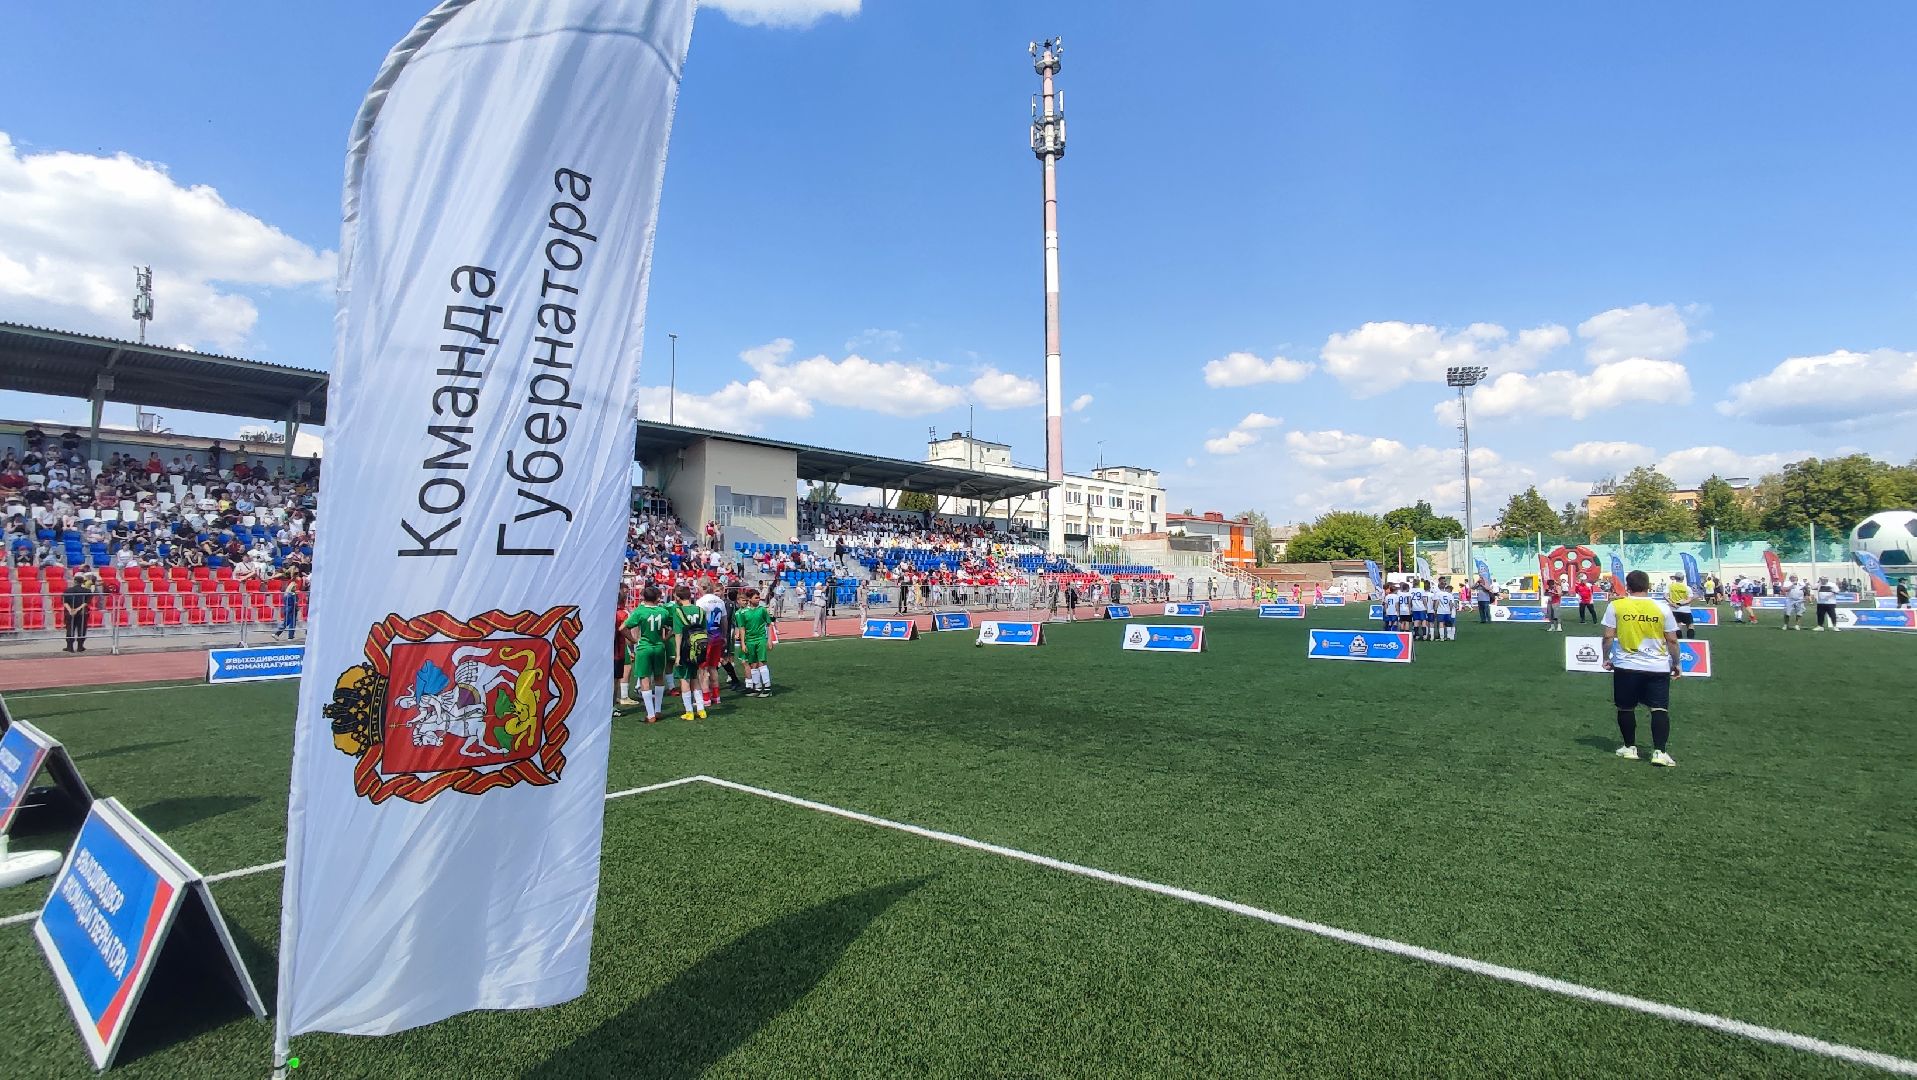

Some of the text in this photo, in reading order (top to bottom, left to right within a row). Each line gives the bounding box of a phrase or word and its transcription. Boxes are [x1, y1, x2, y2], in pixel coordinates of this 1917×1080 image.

[398, 264, 503, 557] Команда
[496, 167, 597, 556] Губернатора
[647, 613, 662, 632] 11
[1622, 613, 1659, 623] СУДЬЯ
